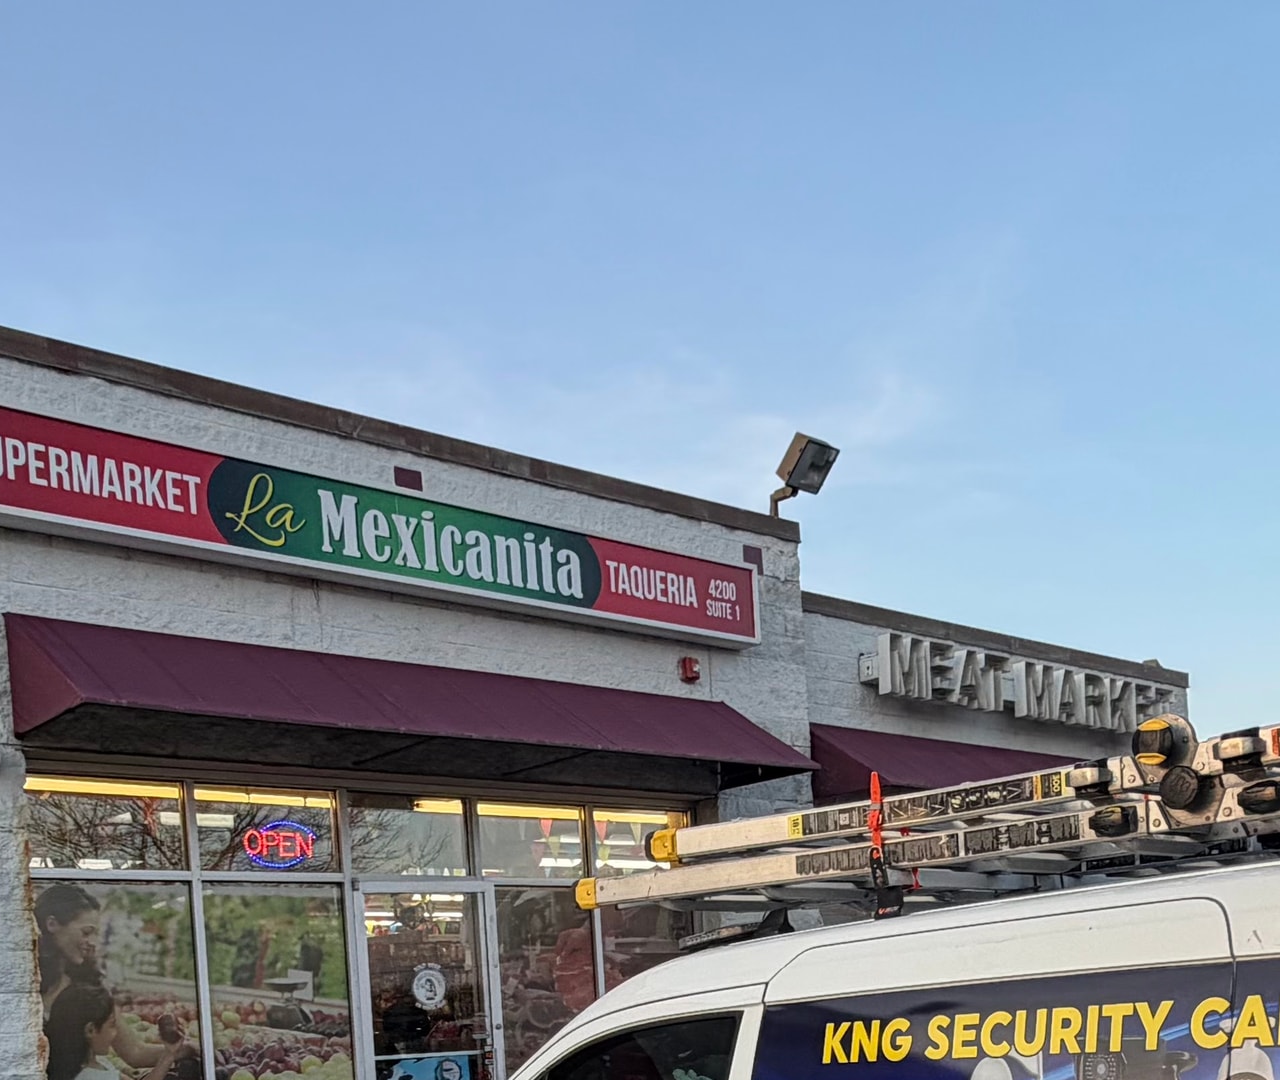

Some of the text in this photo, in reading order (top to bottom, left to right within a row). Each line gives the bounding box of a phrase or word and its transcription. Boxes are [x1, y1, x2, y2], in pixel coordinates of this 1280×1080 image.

[225, 473, 584, 599] La Mexicanita
[606, 560, 698, 608] TAQUERIA
[708, 579, 736, 601] 4200
[706, 599, 740, 622] SUITE 1
[878, 632, 1011, 713] MEAT
[243, 829, 314, 858] OPEN
[822, 1018, 912, 1064] KNG
[924, 1000, 1174, 1060] SECURITY
